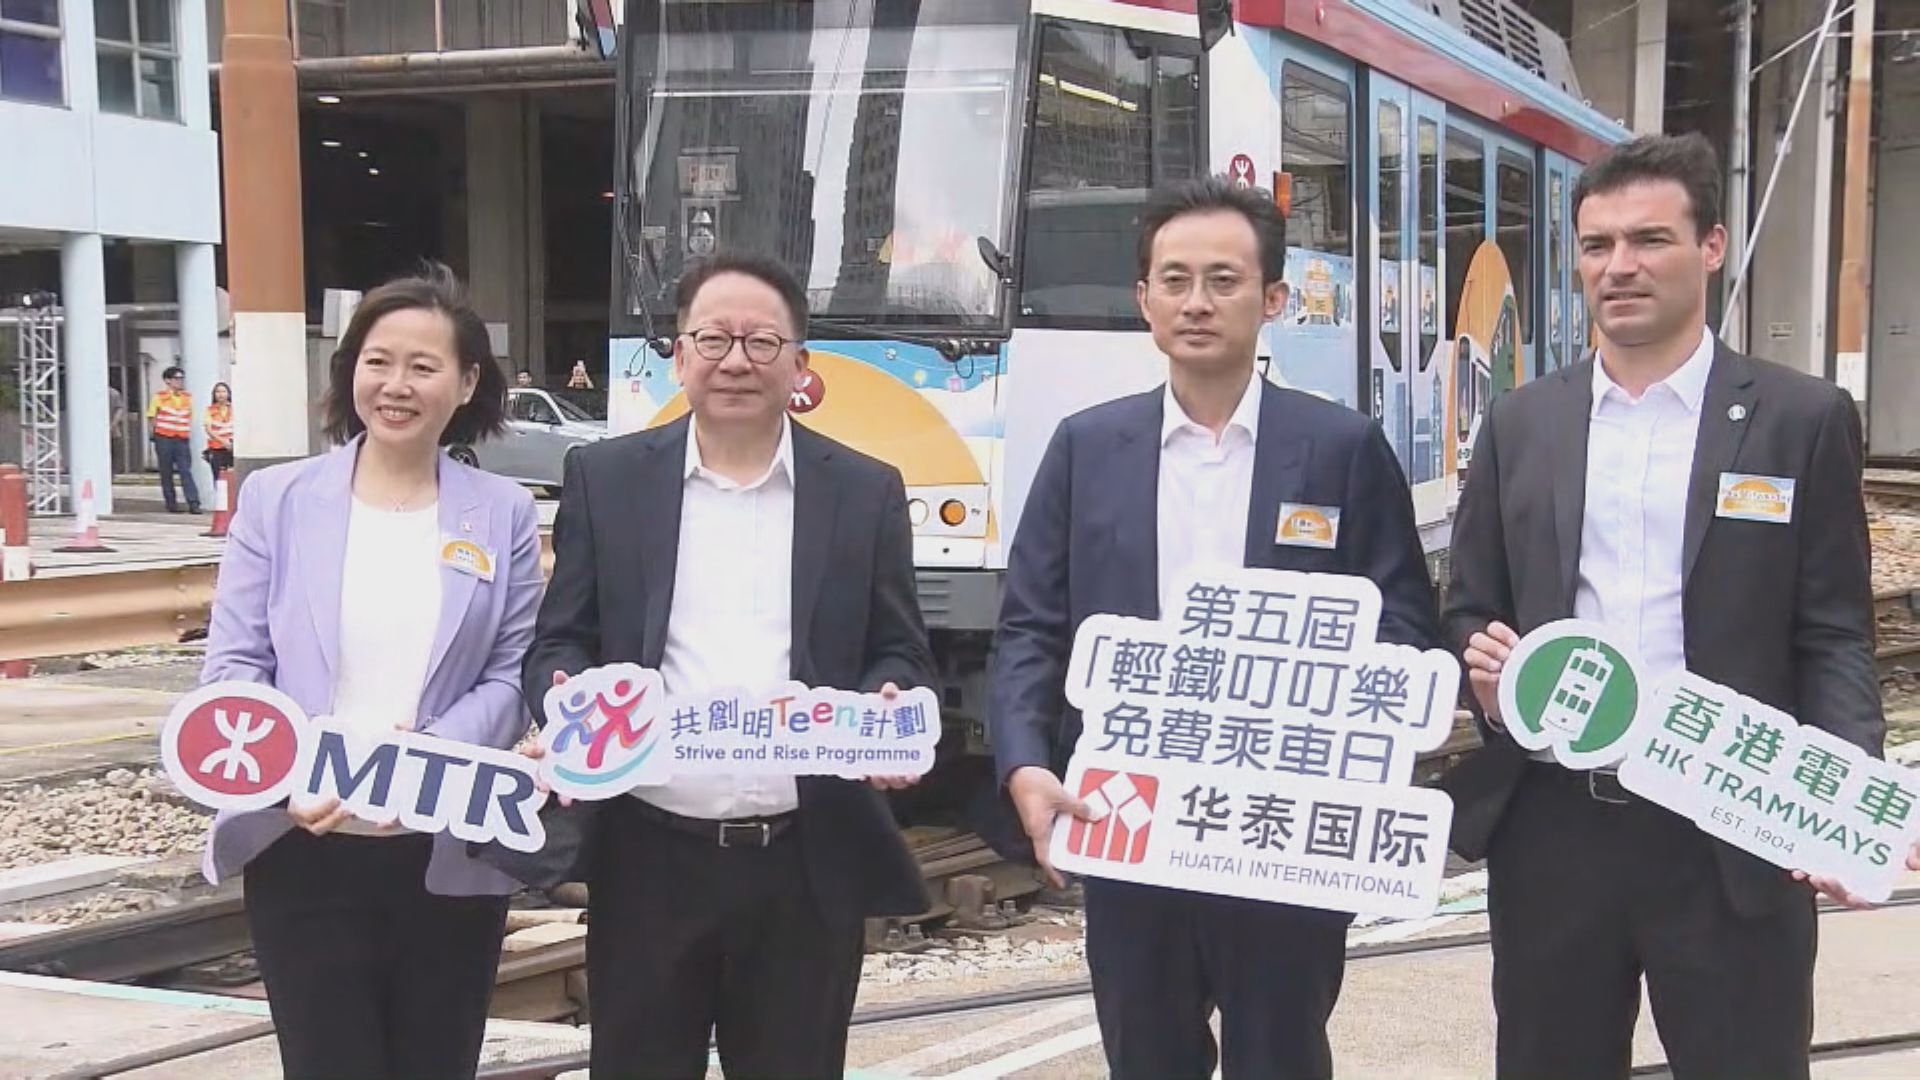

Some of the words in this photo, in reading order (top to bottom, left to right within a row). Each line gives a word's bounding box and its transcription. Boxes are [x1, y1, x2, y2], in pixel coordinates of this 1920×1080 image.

[1179, 582, 1360, 652] 第五屆
[1084, 635, 1438, 728] 「輕鐵叮叮樂」
[307, 730, 535, 836] MTR
[674, 744, 726, 761] Strive
[732, 745, 767, 761] and
[774, 745, 810, 761] Rise
[816, 745, 921, 764] Programme
[1093, 701, 1395, 785] 免費乘車日
[1663, 686, 1919, 830] 香港電車
[1175, 784, 1429, 868] 华泰国际
[1644, 737, 1696, 777] HK
[1702, 762, 1893, 867] TRAMWAYS
[1709, 805, 1747, 834] EST.
[1753, 825, 1796, 855] 1904
[1169, 849, 1244, 876] HUATAI
[1248, 860, 1420, 899] INTERNATIONAL
